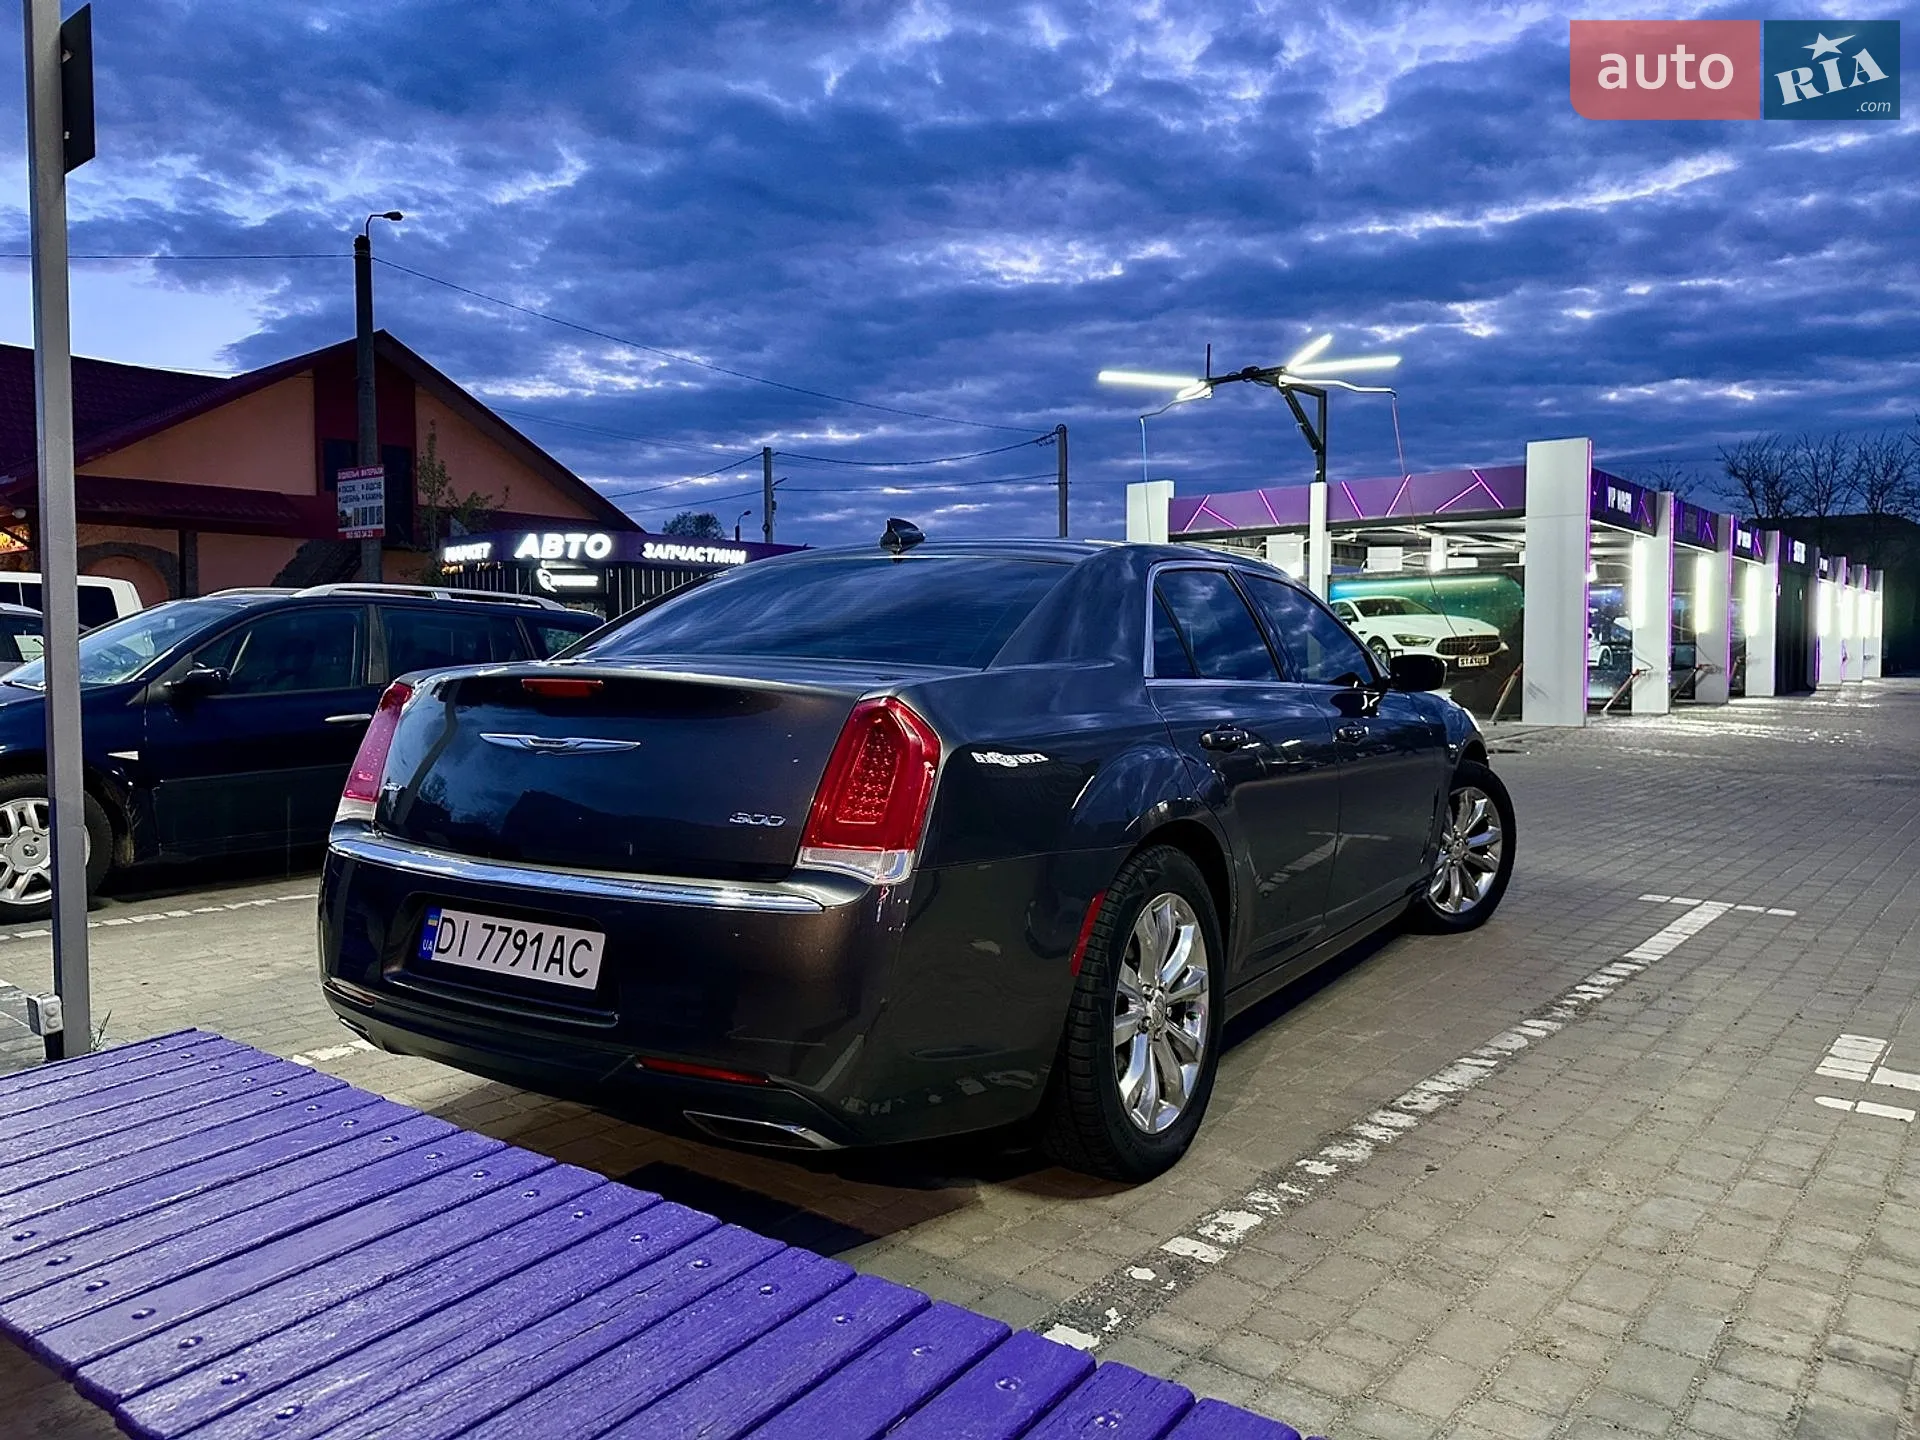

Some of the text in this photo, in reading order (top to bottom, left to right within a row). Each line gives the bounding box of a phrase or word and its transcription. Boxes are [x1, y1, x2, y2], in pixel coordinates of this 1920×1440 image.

[514, 532, 613, 560] АВТО
[642, 542, 747, 564] ЗАПЧАСТИНИ
[729, 812, 787, 827] 300
[422, 939, 433, 951] UA
[434, 916, 470, 957] DI
